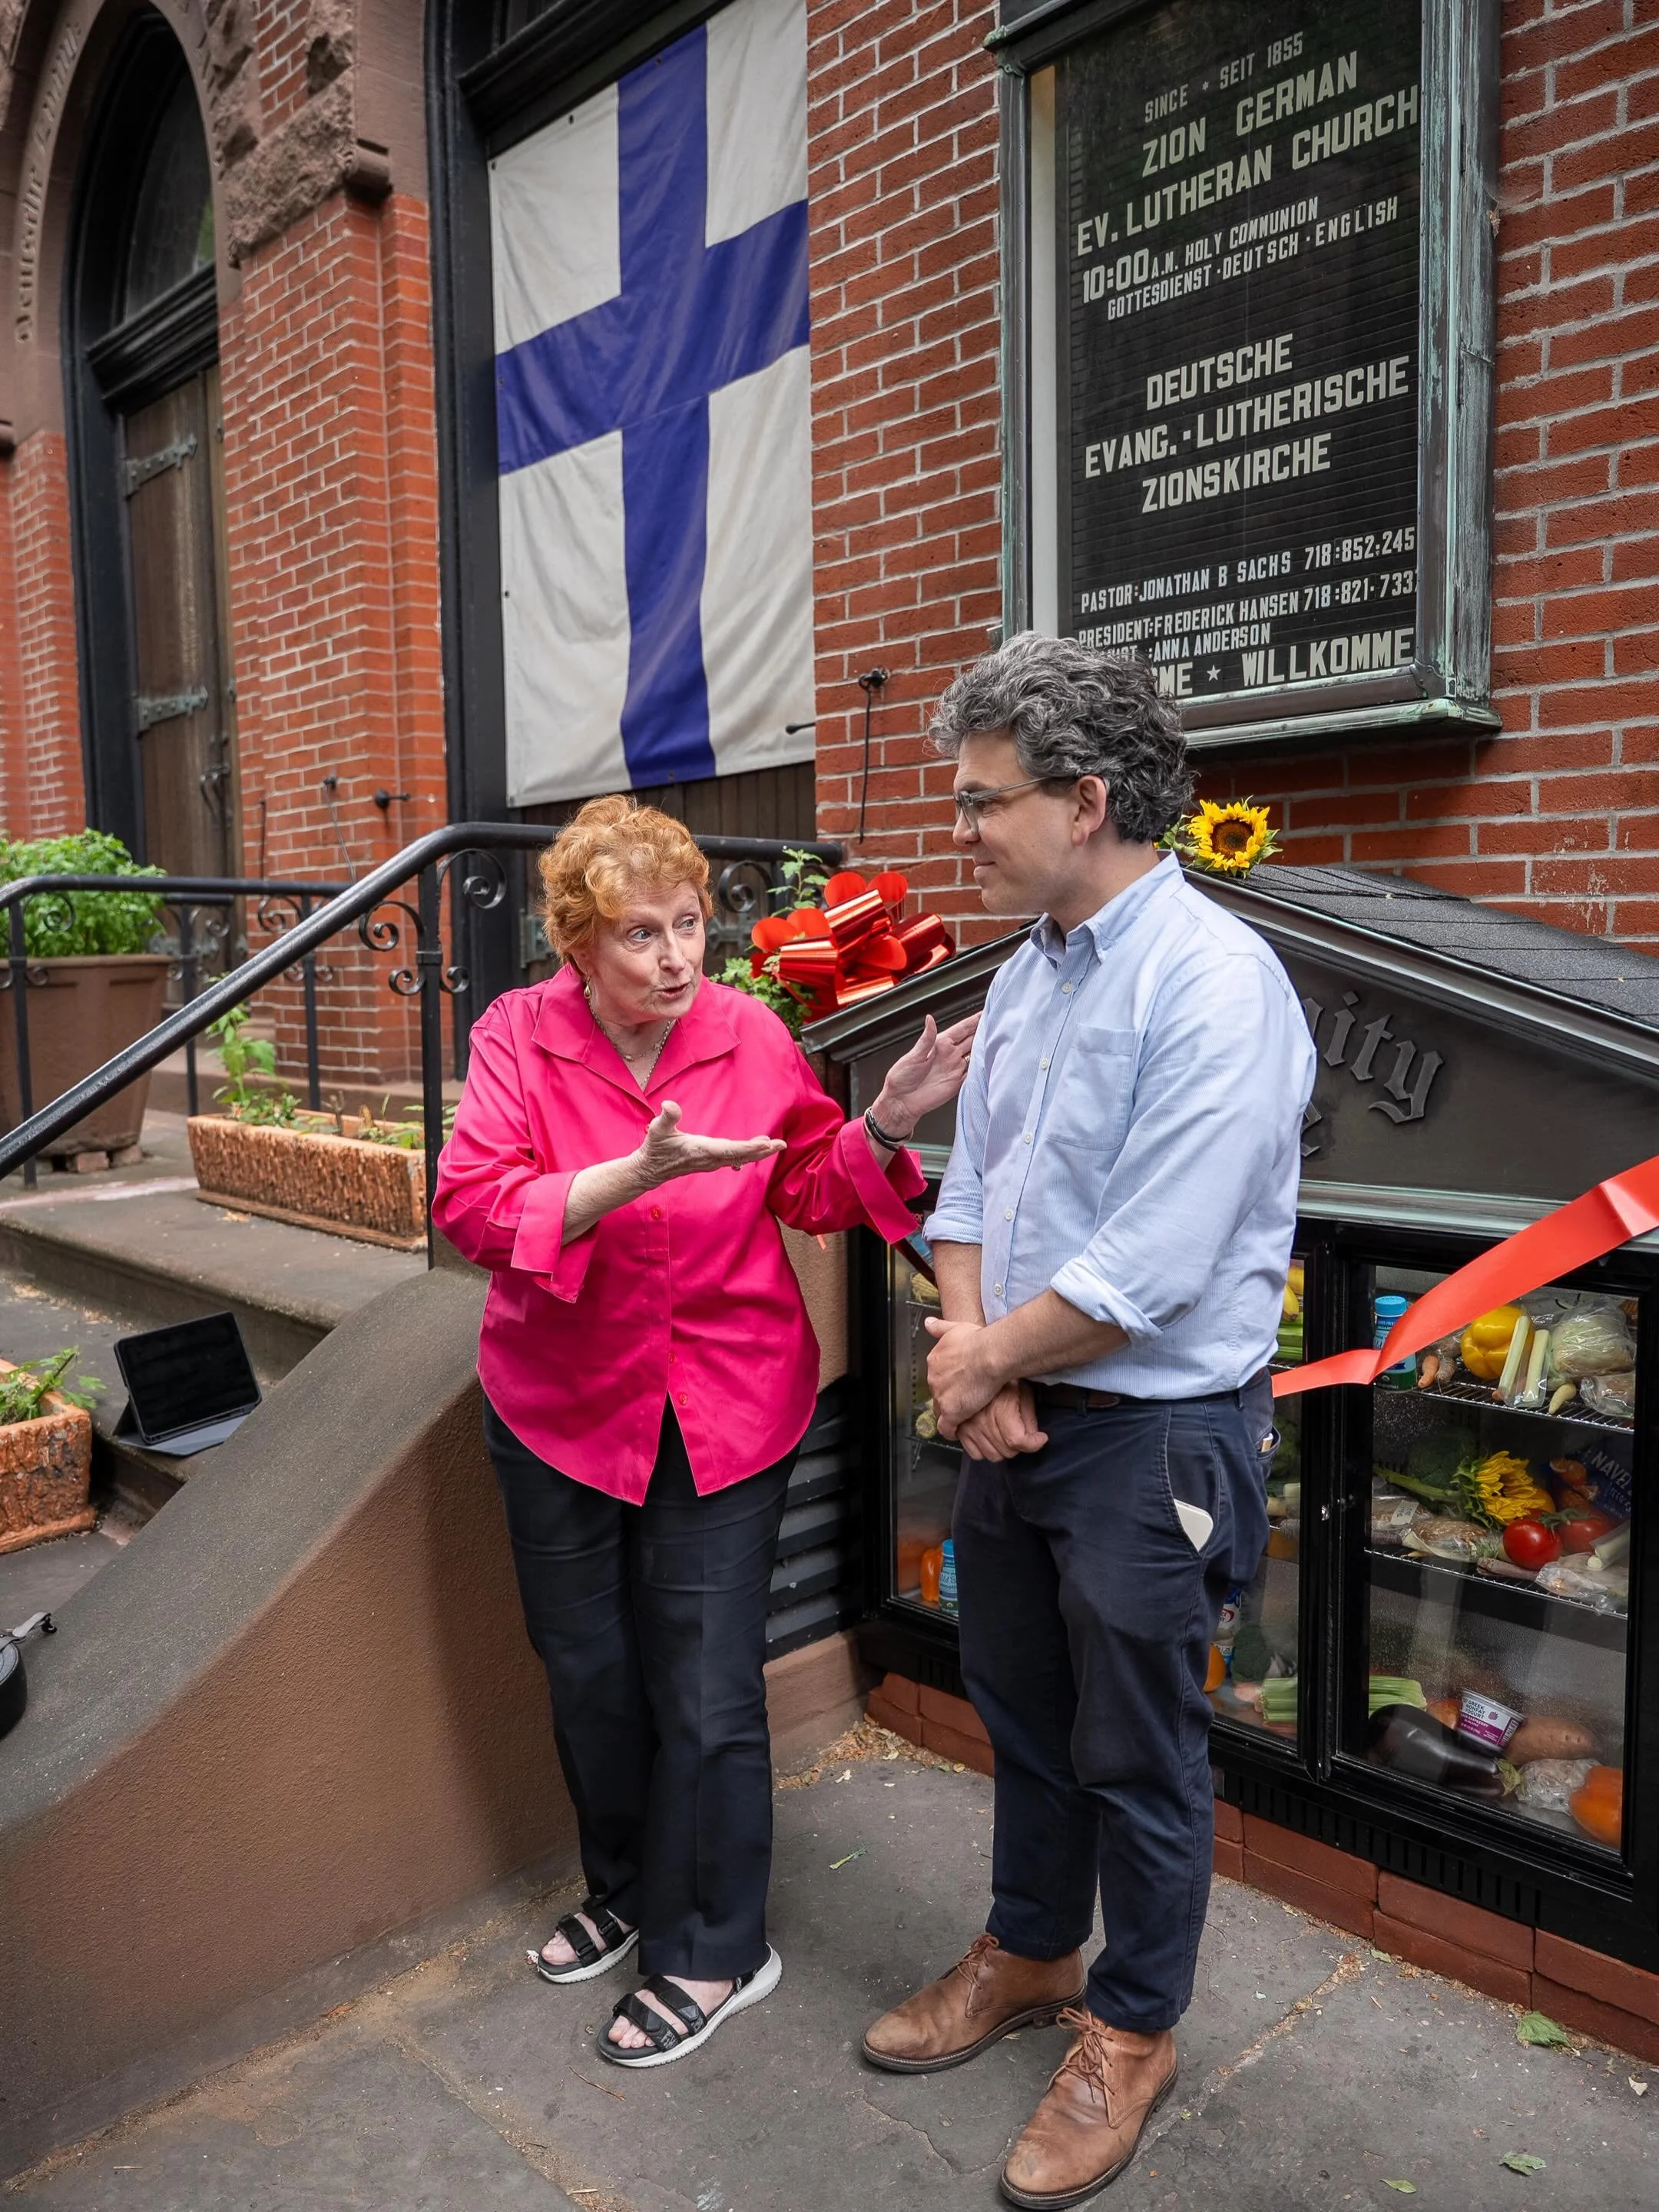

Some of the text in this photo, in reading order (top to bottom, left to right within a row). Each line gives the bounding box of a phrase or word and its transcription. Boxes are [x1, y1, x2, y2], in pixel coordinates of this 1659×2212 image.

[1144, 31, 1303, 124] SINCE SEIT 1855
[1142, 51, 1357, 177] ZION GERMAN
[1077, 84, 1418, 257] EV. LUTHERAN CHURCH
[1185, 235, 1221, 267] HOLY
[1230, 197, 1319, 250] COMMUNION
[1108, 264, 1212, 320] GOTTESDIENST
[1146, 334, 1293, 410] DEUTSCHE
[1142, 433, 1331, 514] ZIONSKIRCHE
[1218, 566, 1228, 587] B
[1237, 551, 1291, 582] SACHS
[1194, 622, 1270, 657] ANDERSON
[1240, 590, 1300, 621] HANSEN
[1468, 1700, 1485, 1710] GREEK
